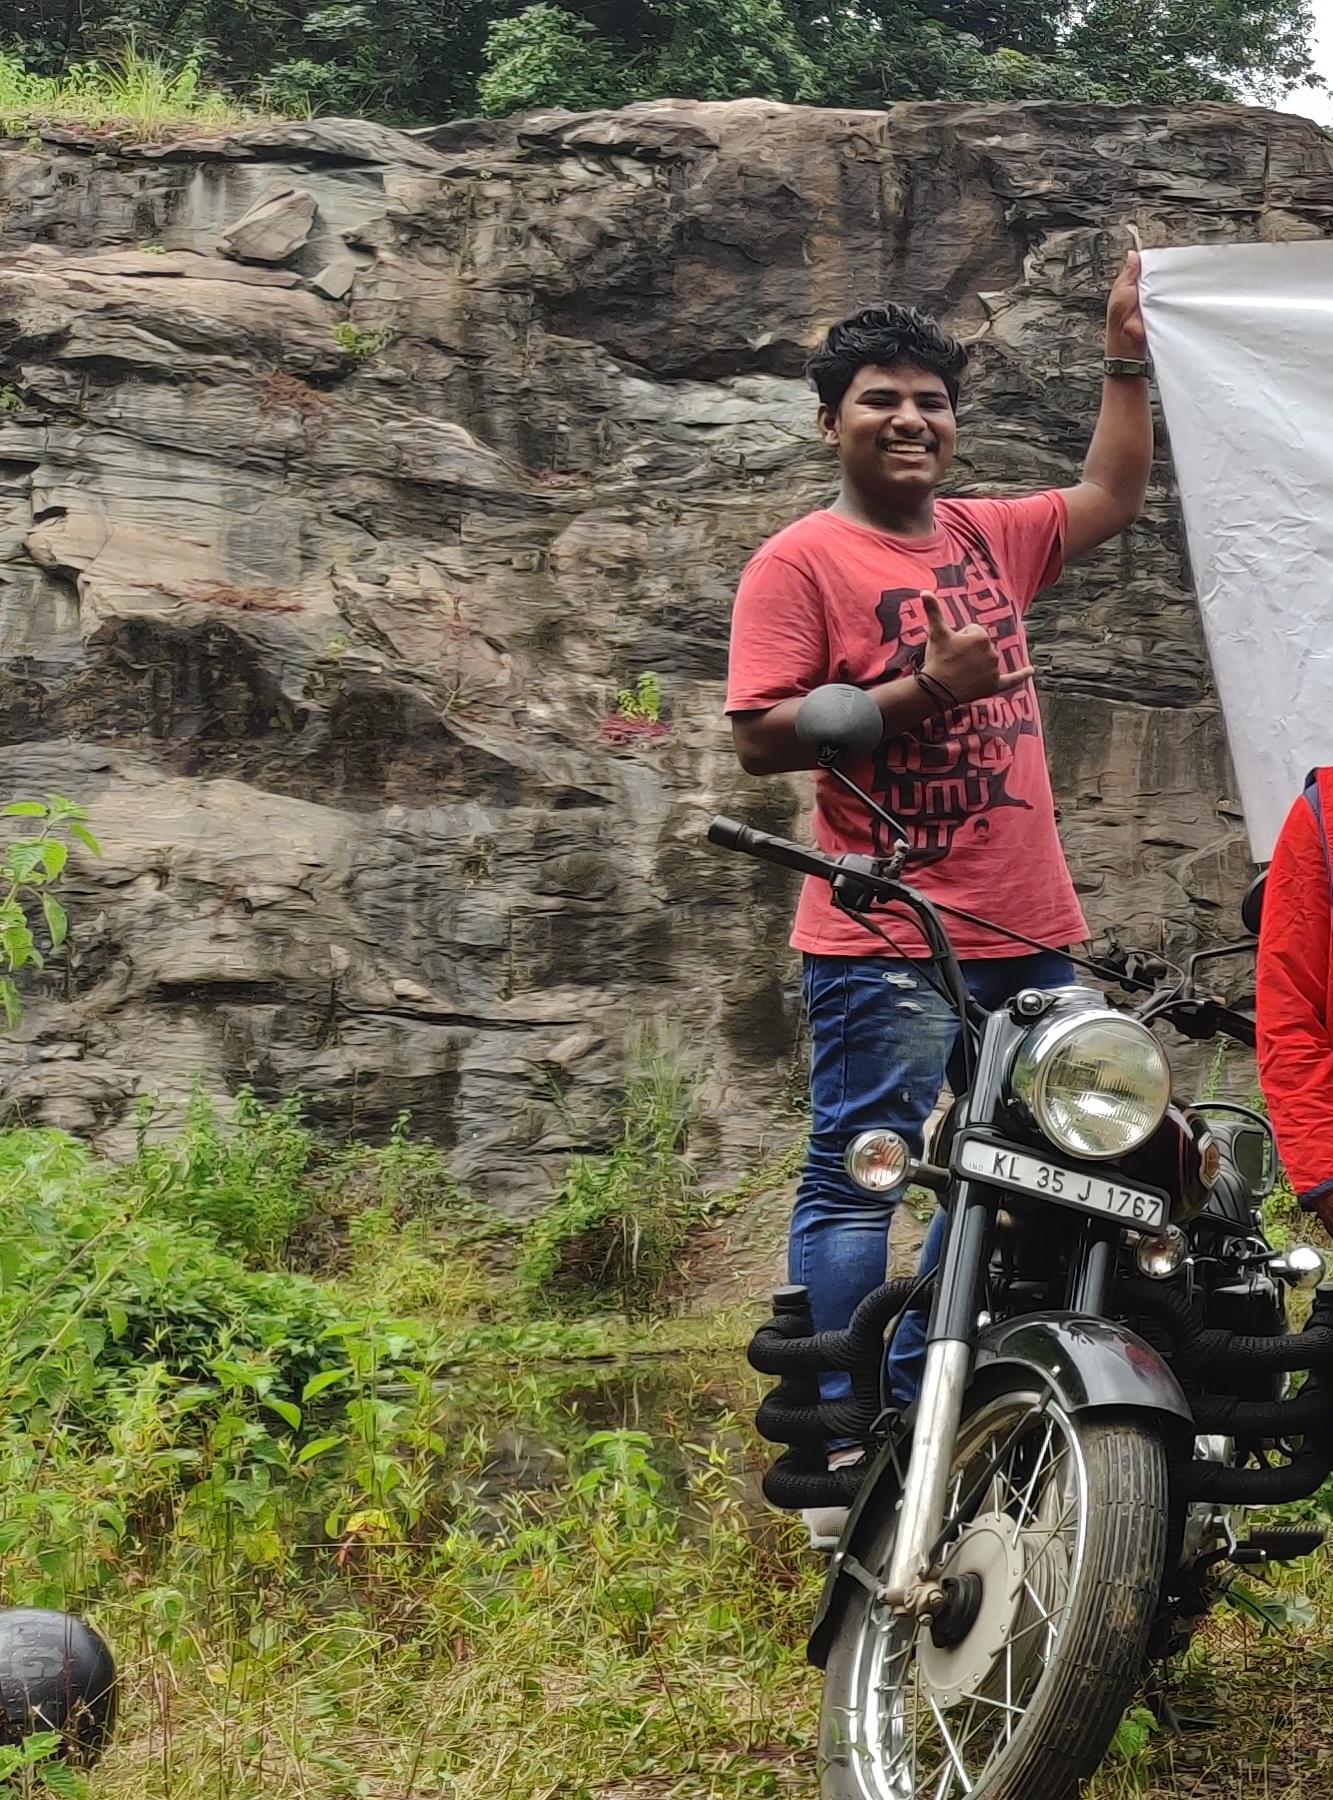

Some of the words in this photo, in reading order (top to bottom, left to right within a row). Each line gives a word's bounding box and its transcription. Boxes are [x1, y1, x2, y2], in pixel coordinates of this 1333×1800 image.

[992, 1151, 1022, 1182] KL
[1036, 1166, 1066, 1194] 35
[1077, 1180, 1093, 1201] J
[1105, 1186, 1161, 1223] 1767
